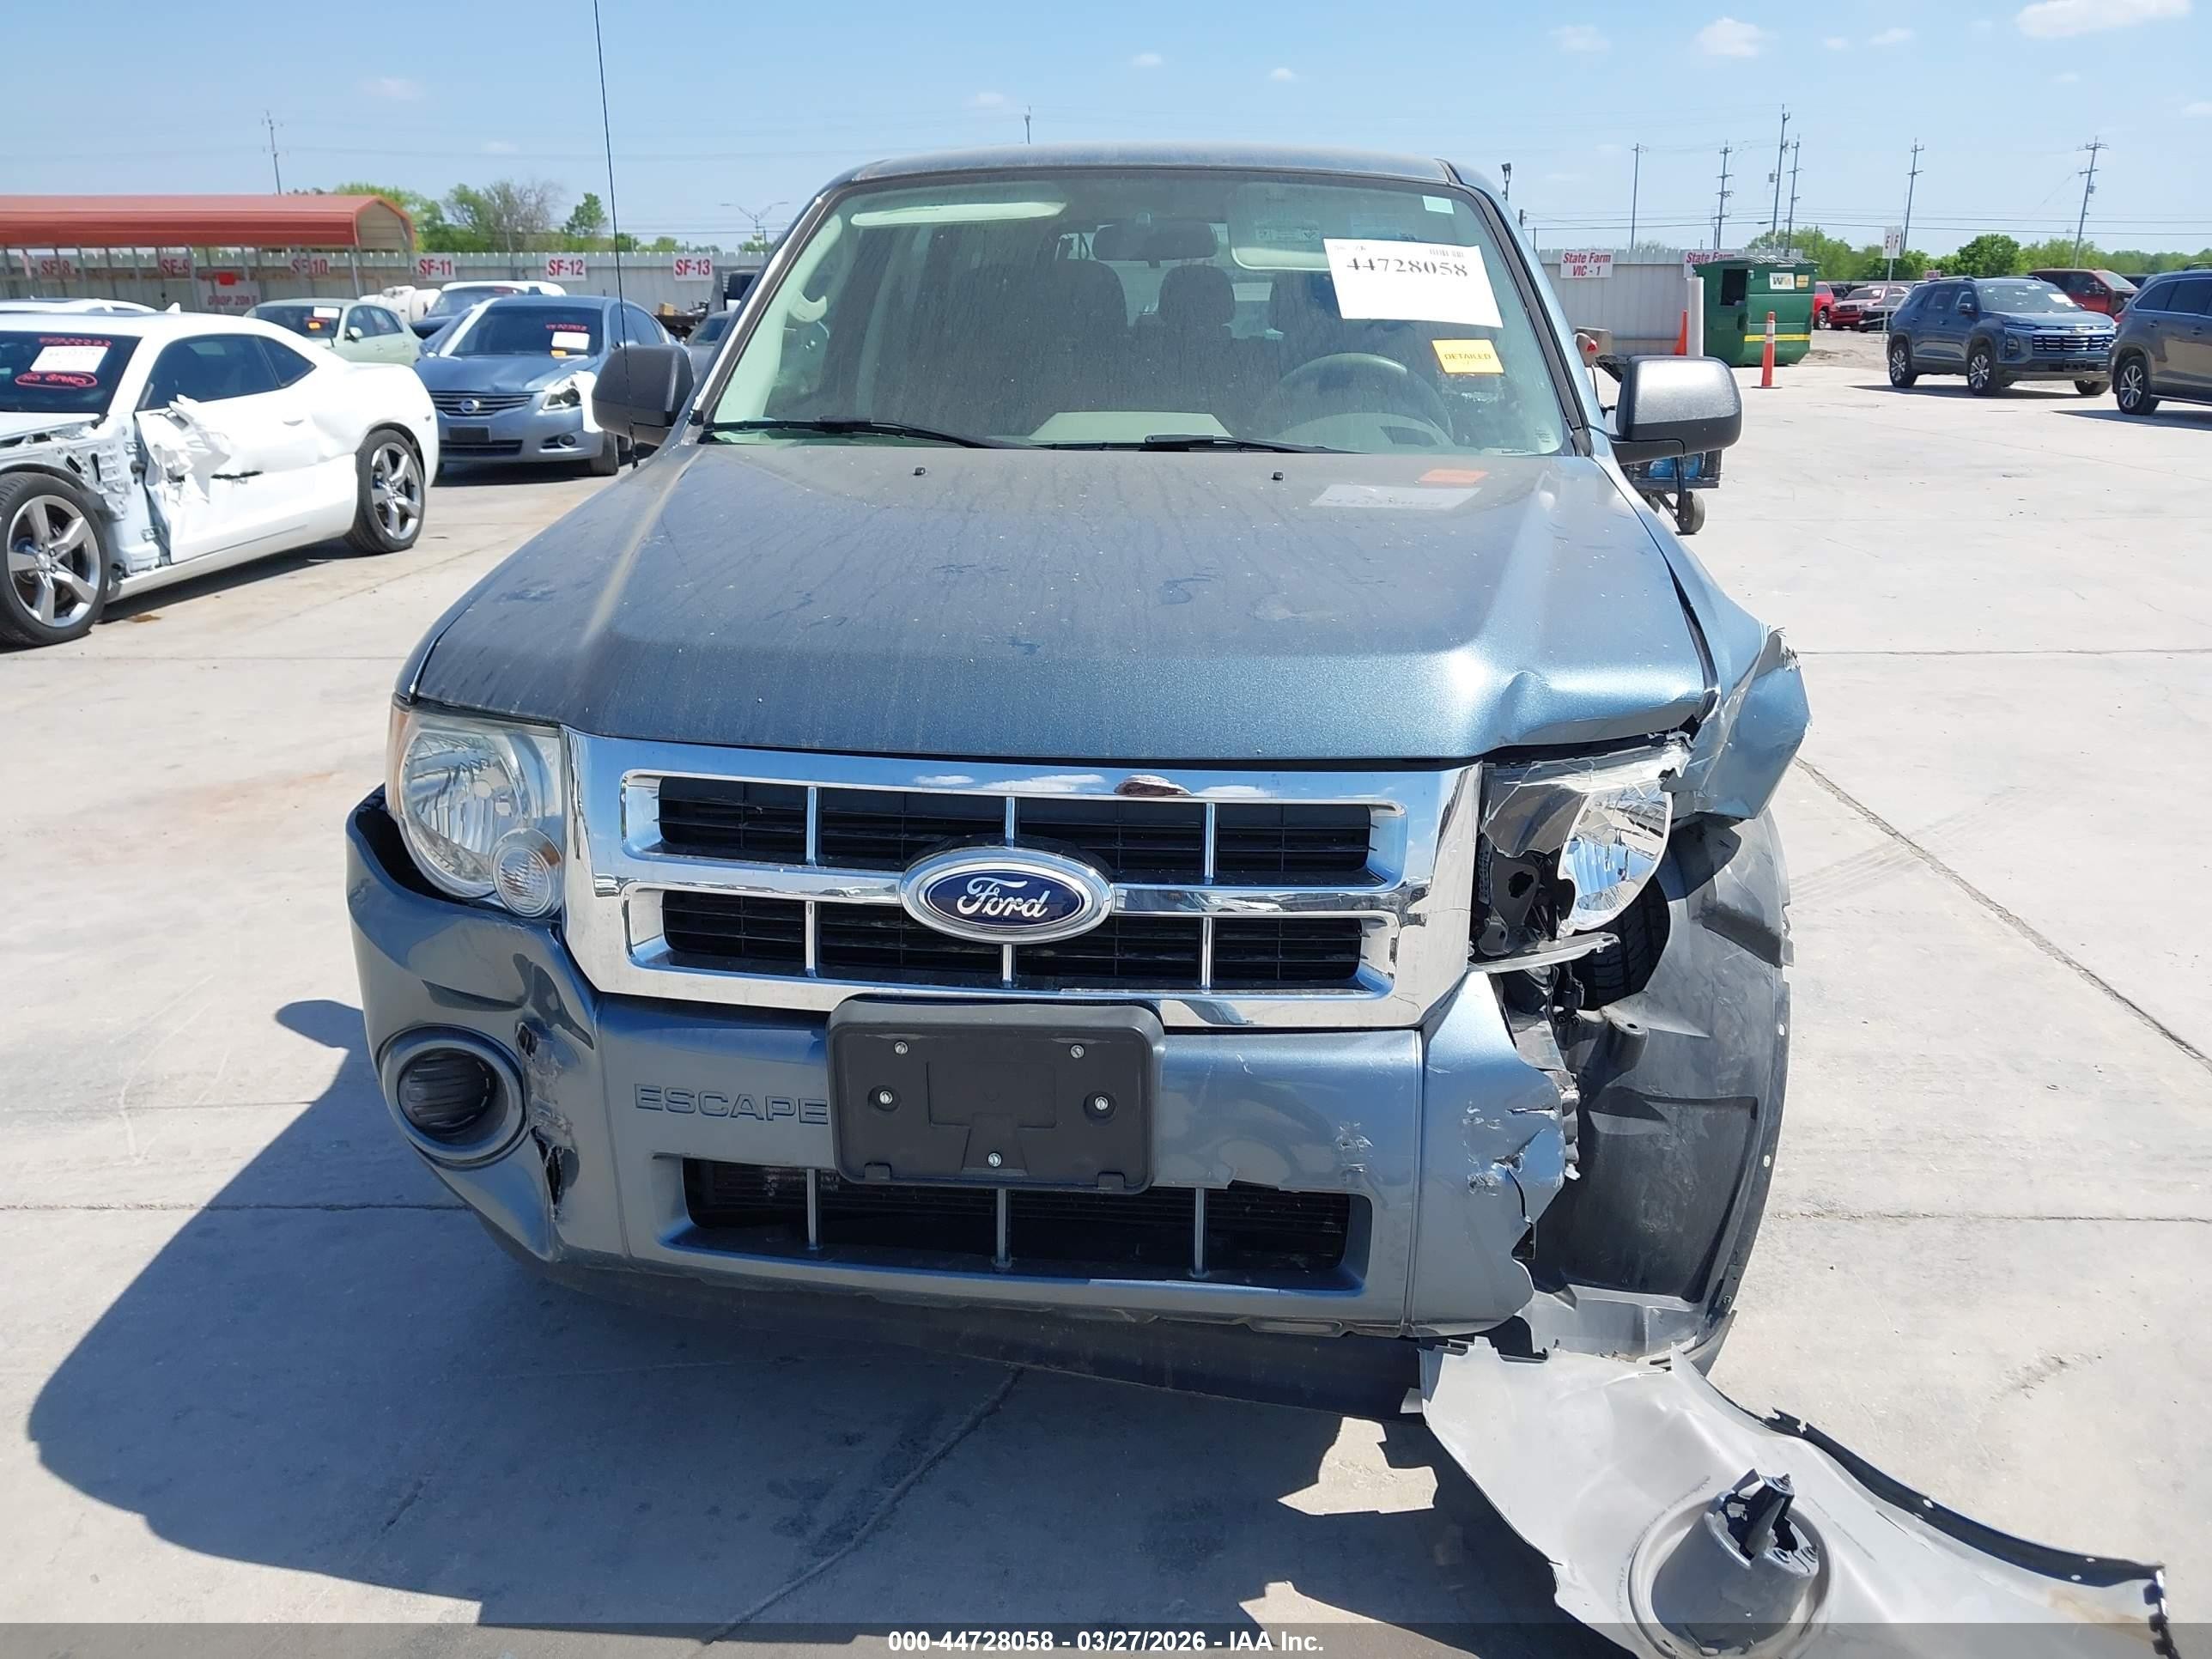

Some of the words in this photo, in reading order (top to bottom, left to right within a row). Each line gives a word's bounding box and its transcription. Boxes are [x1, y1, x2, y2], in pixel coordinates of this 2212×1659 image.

[418, 258, 453, 276] SF-11
[548, 258, 585, 276] SF-12
[675, 258, 711, 276] SF-13
[1346, 257, 1468, 277] 44728058
[1563, 252, 1587, 264] State
[1589, 252, 1612, 264] Farm
[1686, 252, 1711, 264] State
[1572, 264, 1588, 276] VIC
[1595, 265, 1601, 276] 1
[956, 876, 1051, 918] Ford
[634, 1083, 830, 1125] ESCAPE
